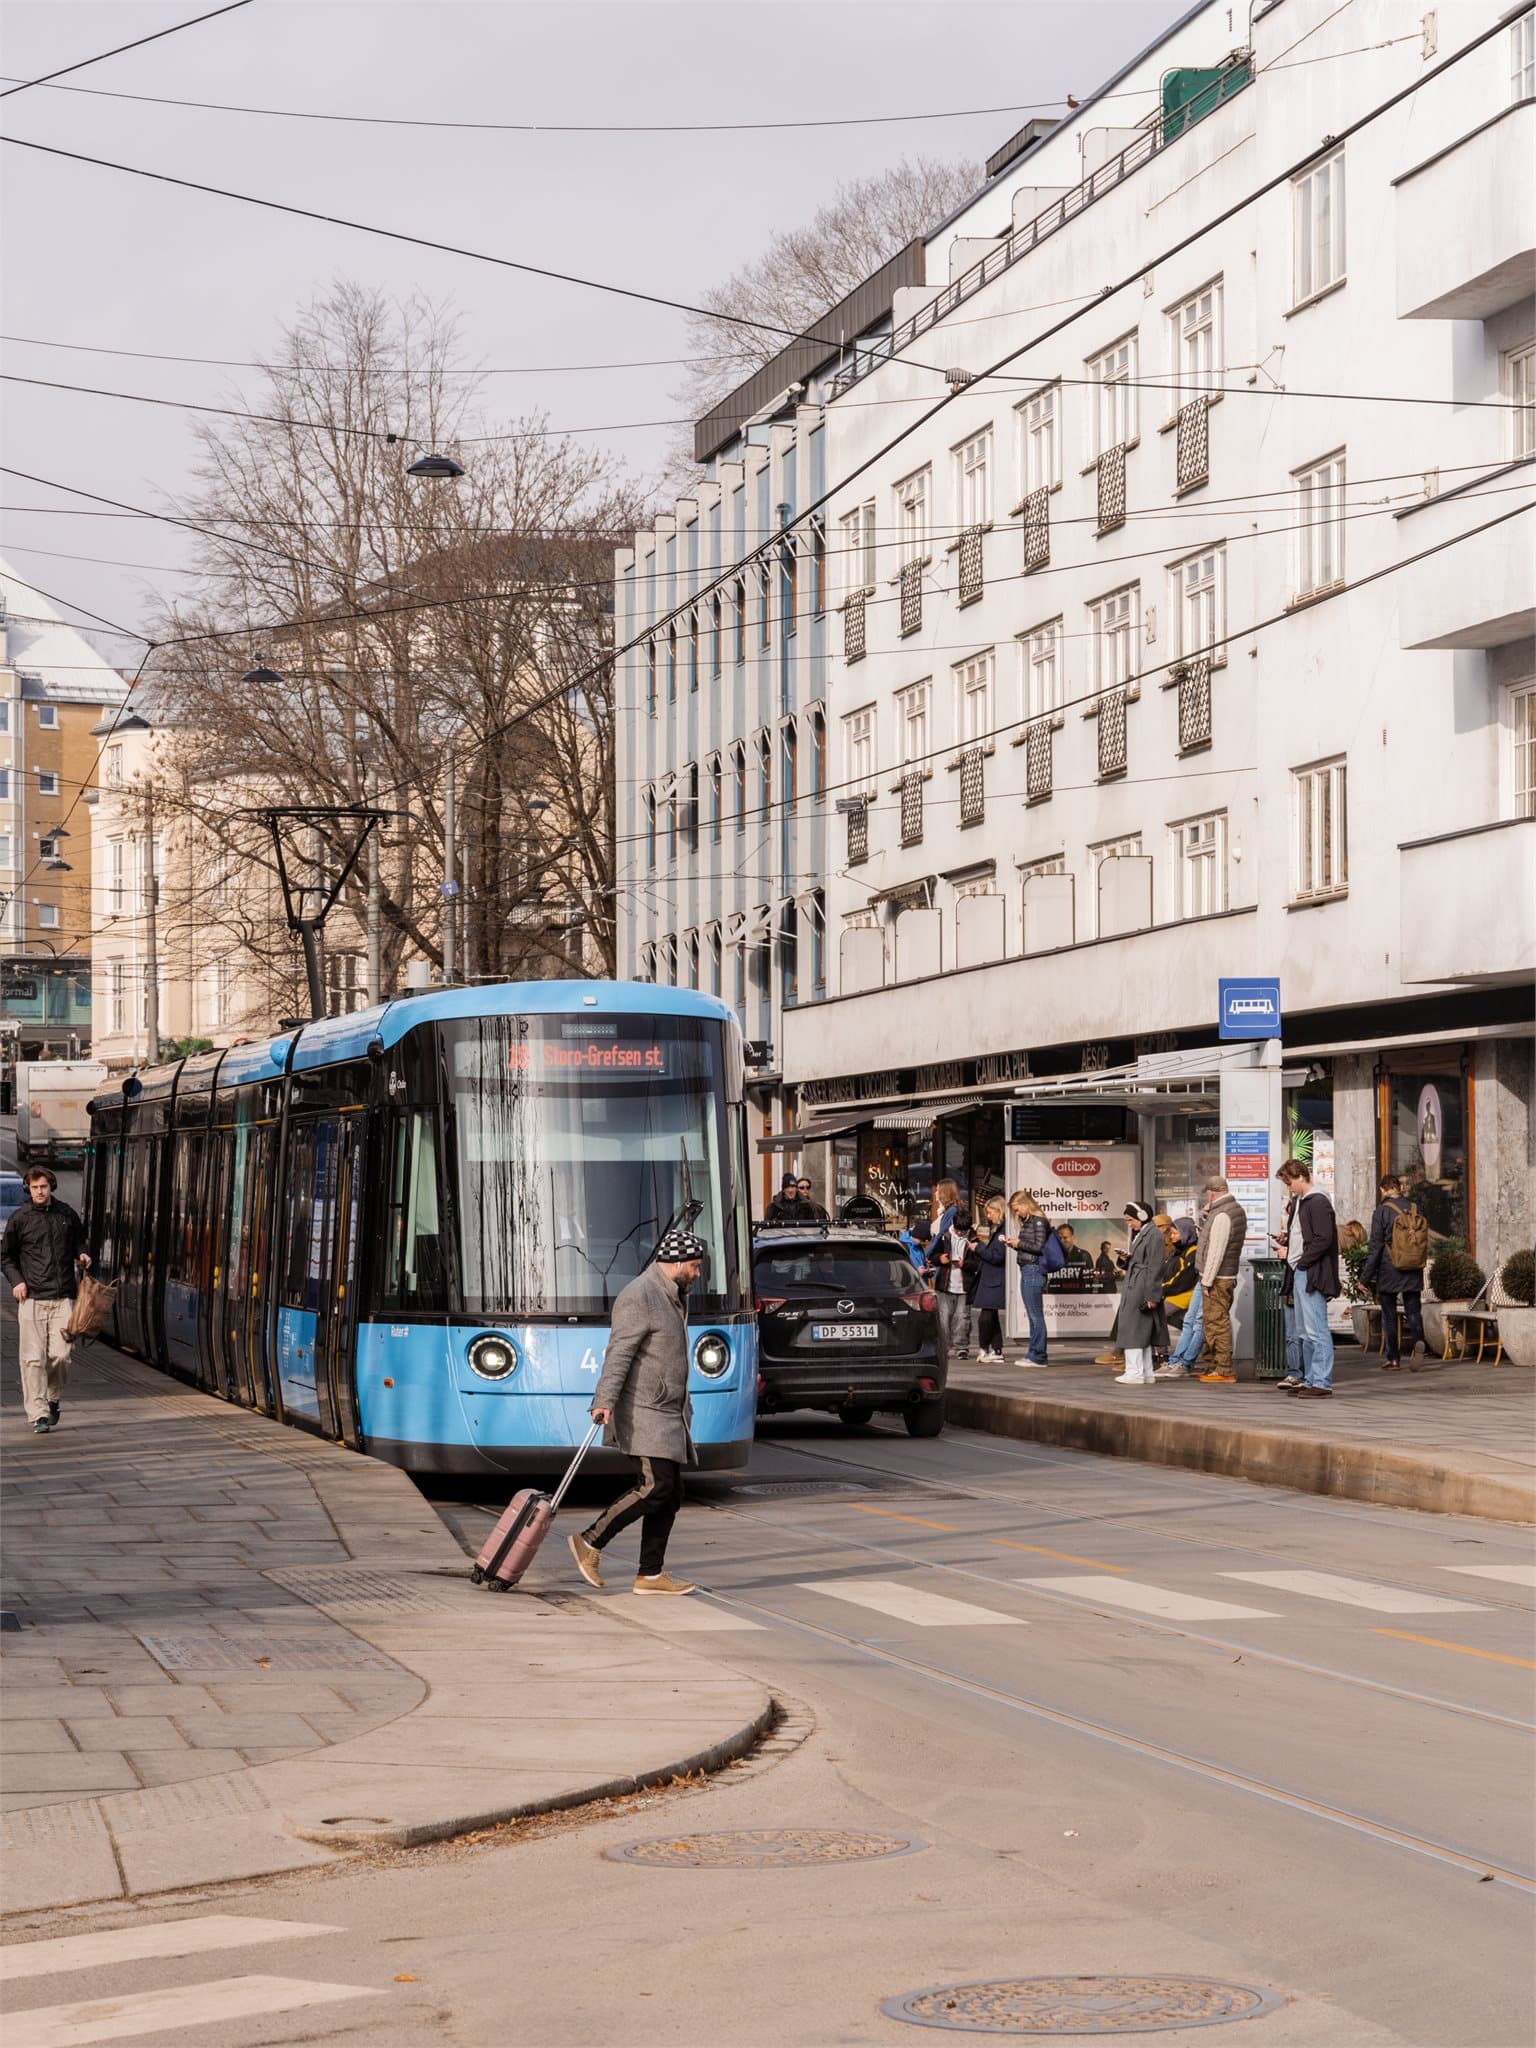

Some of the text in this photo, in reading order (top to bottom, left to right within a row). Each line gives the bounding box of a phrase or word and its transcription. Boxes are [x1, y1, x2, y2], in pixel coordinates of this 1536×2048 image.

[543, 1045, 641, 1066] Storo-Grefsen
[645, 1046, 664, 1066] st.
[976, 1051, 1034, 1085] CAMILLA PIHL
[1056, 1160, 1097, 1172] altibox
[822, 1326, 874, 1337] DP 55314
[580, 1347, 606, 1374] 4
